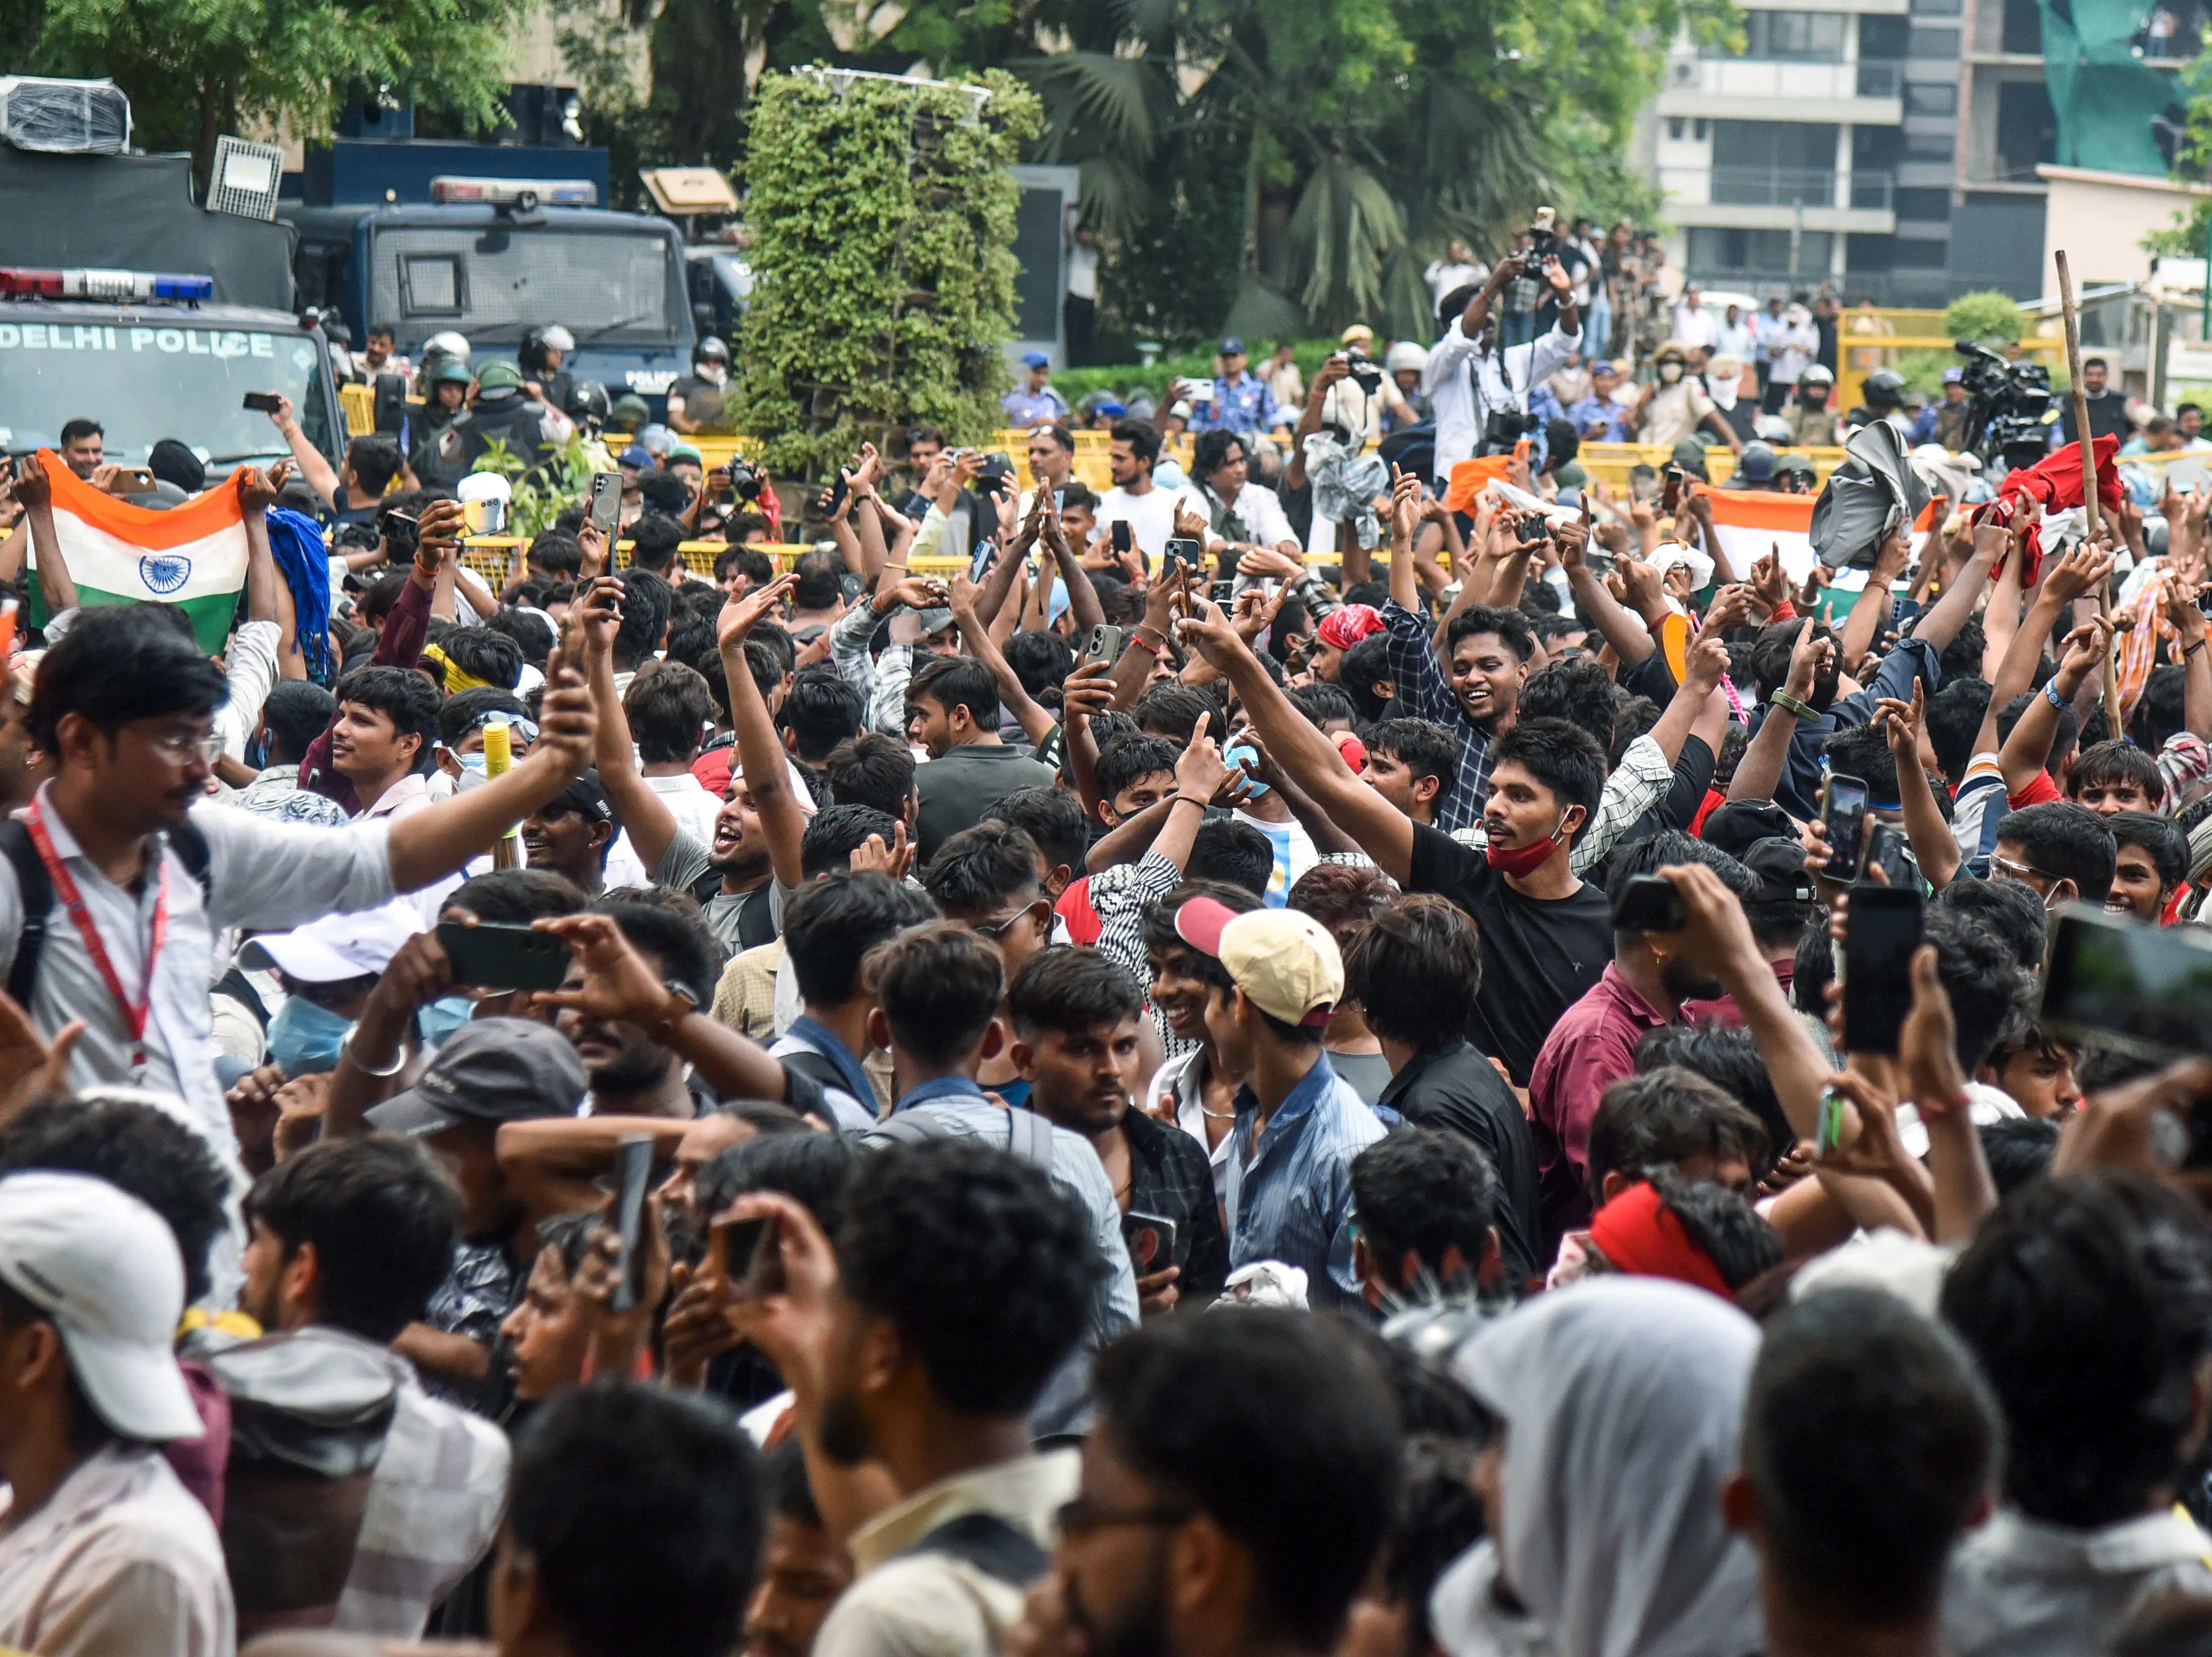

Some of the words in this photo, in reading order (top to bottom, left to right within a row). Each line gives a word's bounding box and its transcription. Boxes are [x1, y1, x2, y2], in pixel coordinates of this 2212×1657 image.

[0, 323, 116, 351] DELHI
[131, 327, 274, 359] POLICE
[596, 799, 612, 818] NIKE
